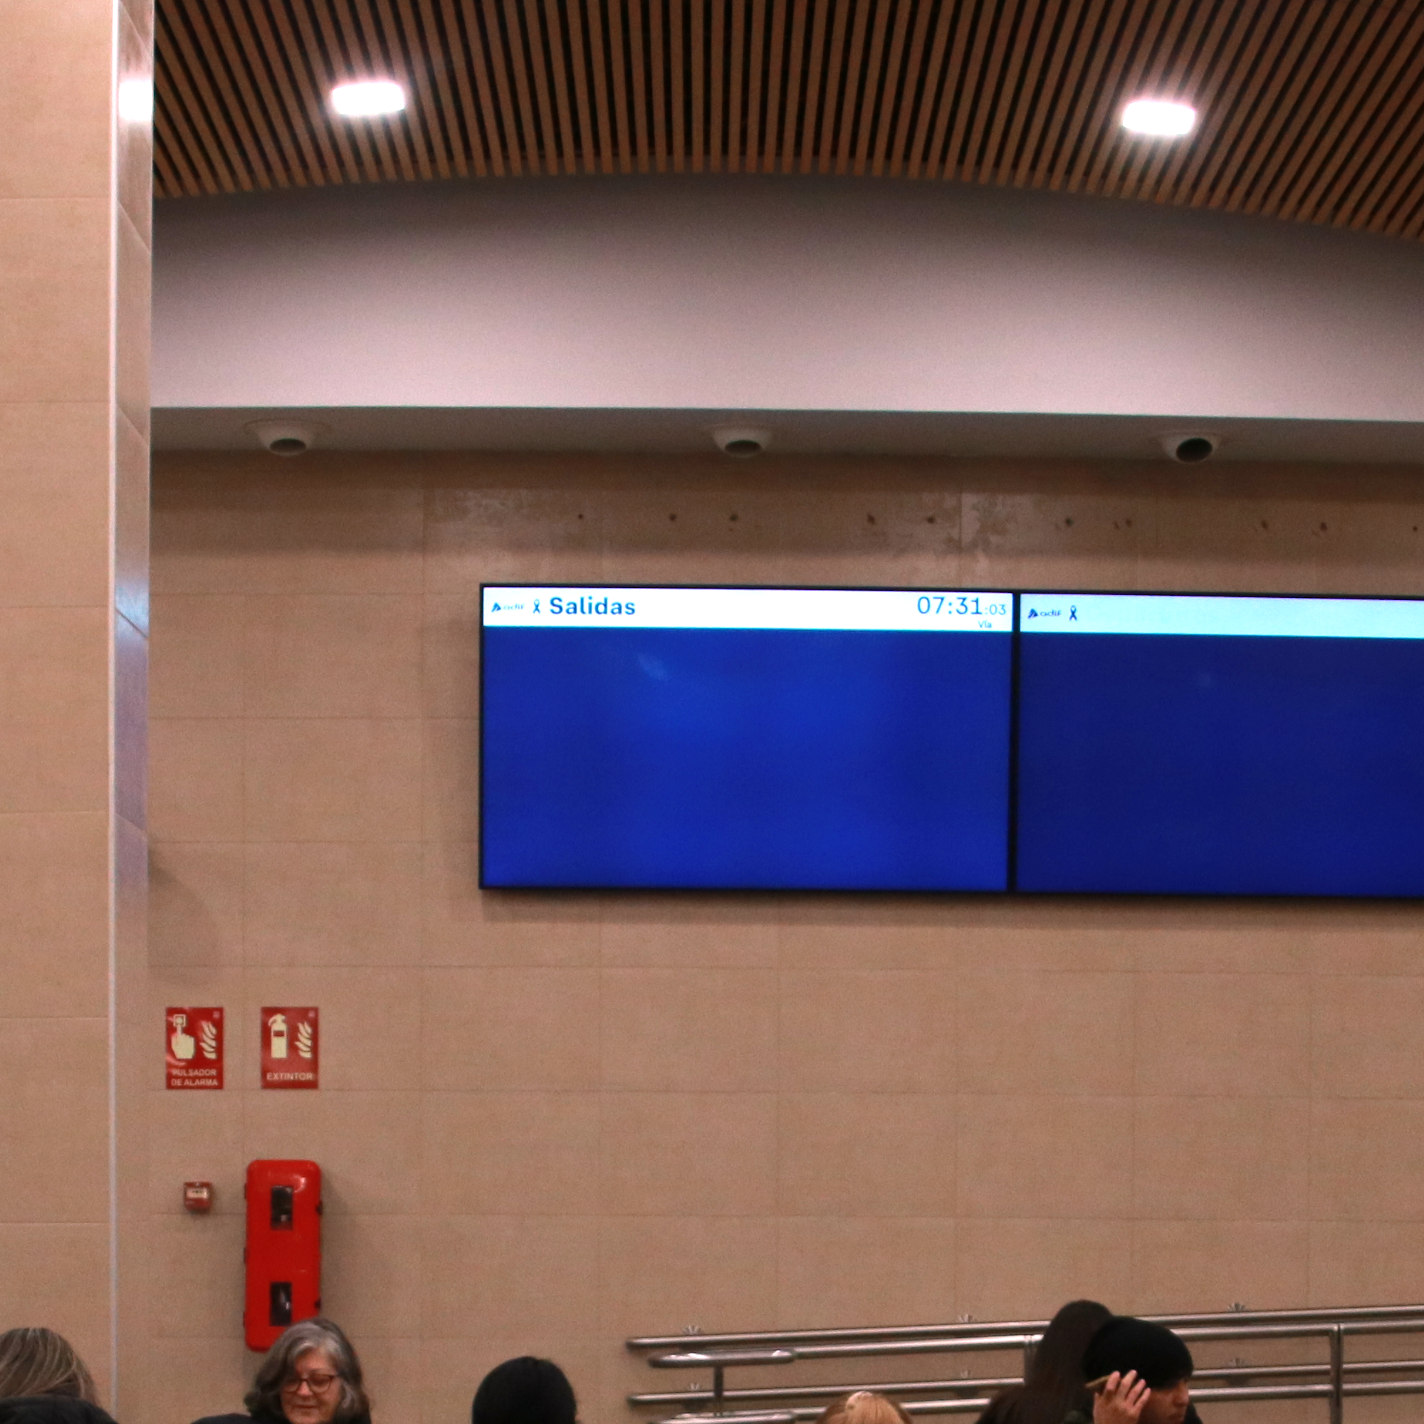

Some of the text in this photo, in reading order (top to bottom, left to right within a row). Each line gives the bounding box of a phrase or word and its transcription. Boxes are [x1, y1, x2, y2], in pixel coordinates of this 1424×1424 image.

[549, 595, 636, 615] Salidas
[1039, 609, 1062, 617] adif
[172, 1068, 217, 1077] PULSADOR
[266, 1072, 314, 1081] EXTINTOR
[171, 1078, 219, 1087] DE ALARMA
